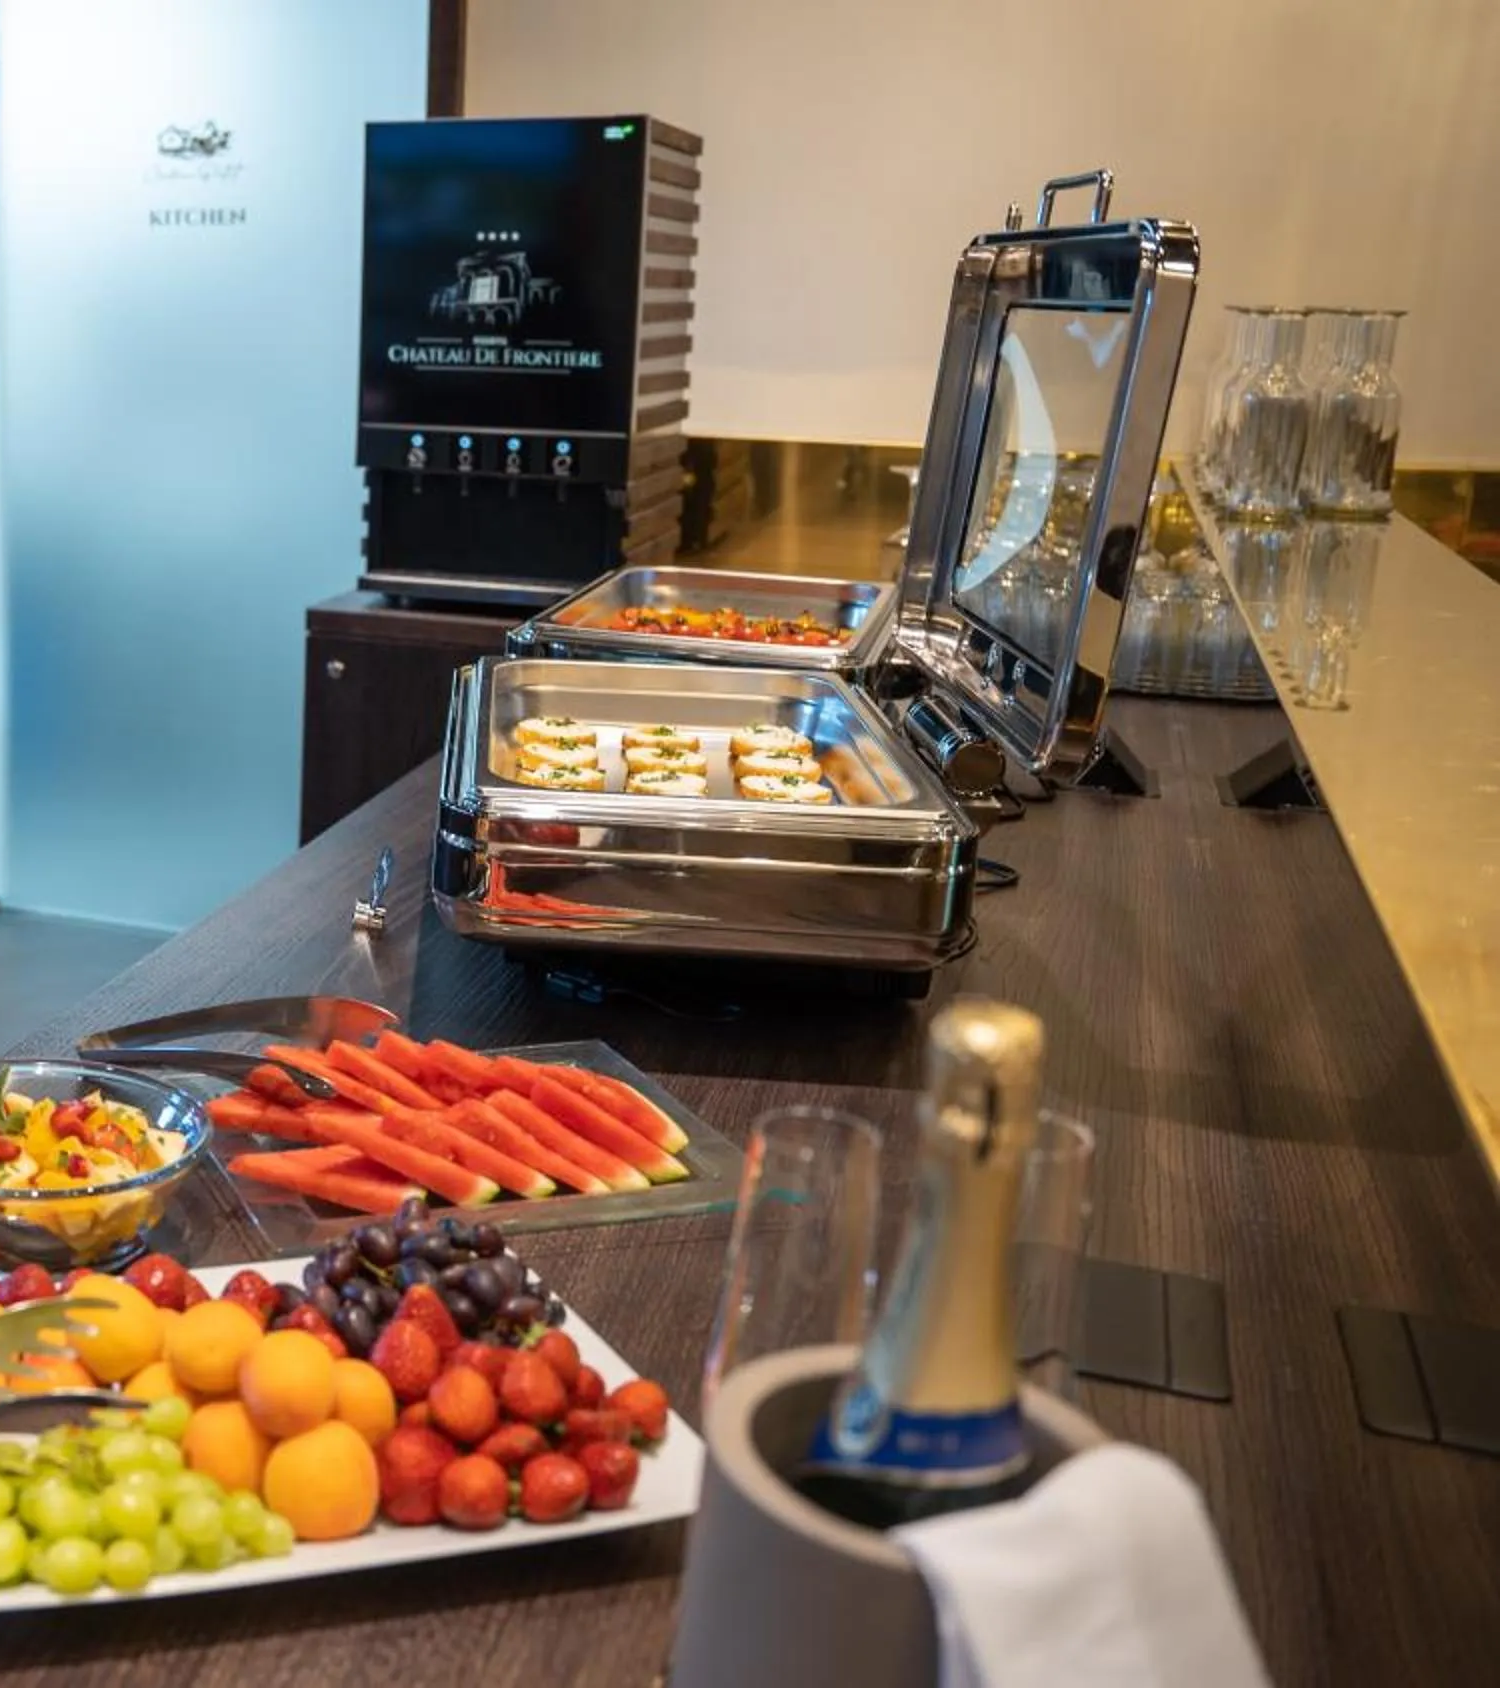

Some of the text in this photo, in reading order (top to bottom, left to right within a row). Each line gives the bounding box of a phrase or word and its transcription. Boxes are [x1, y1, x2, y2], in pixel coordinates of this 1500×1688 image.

[149, 208, 246, 226] KITCHEN
[388, 345, 603, 368] CHATEAU DE FRONTIERE
